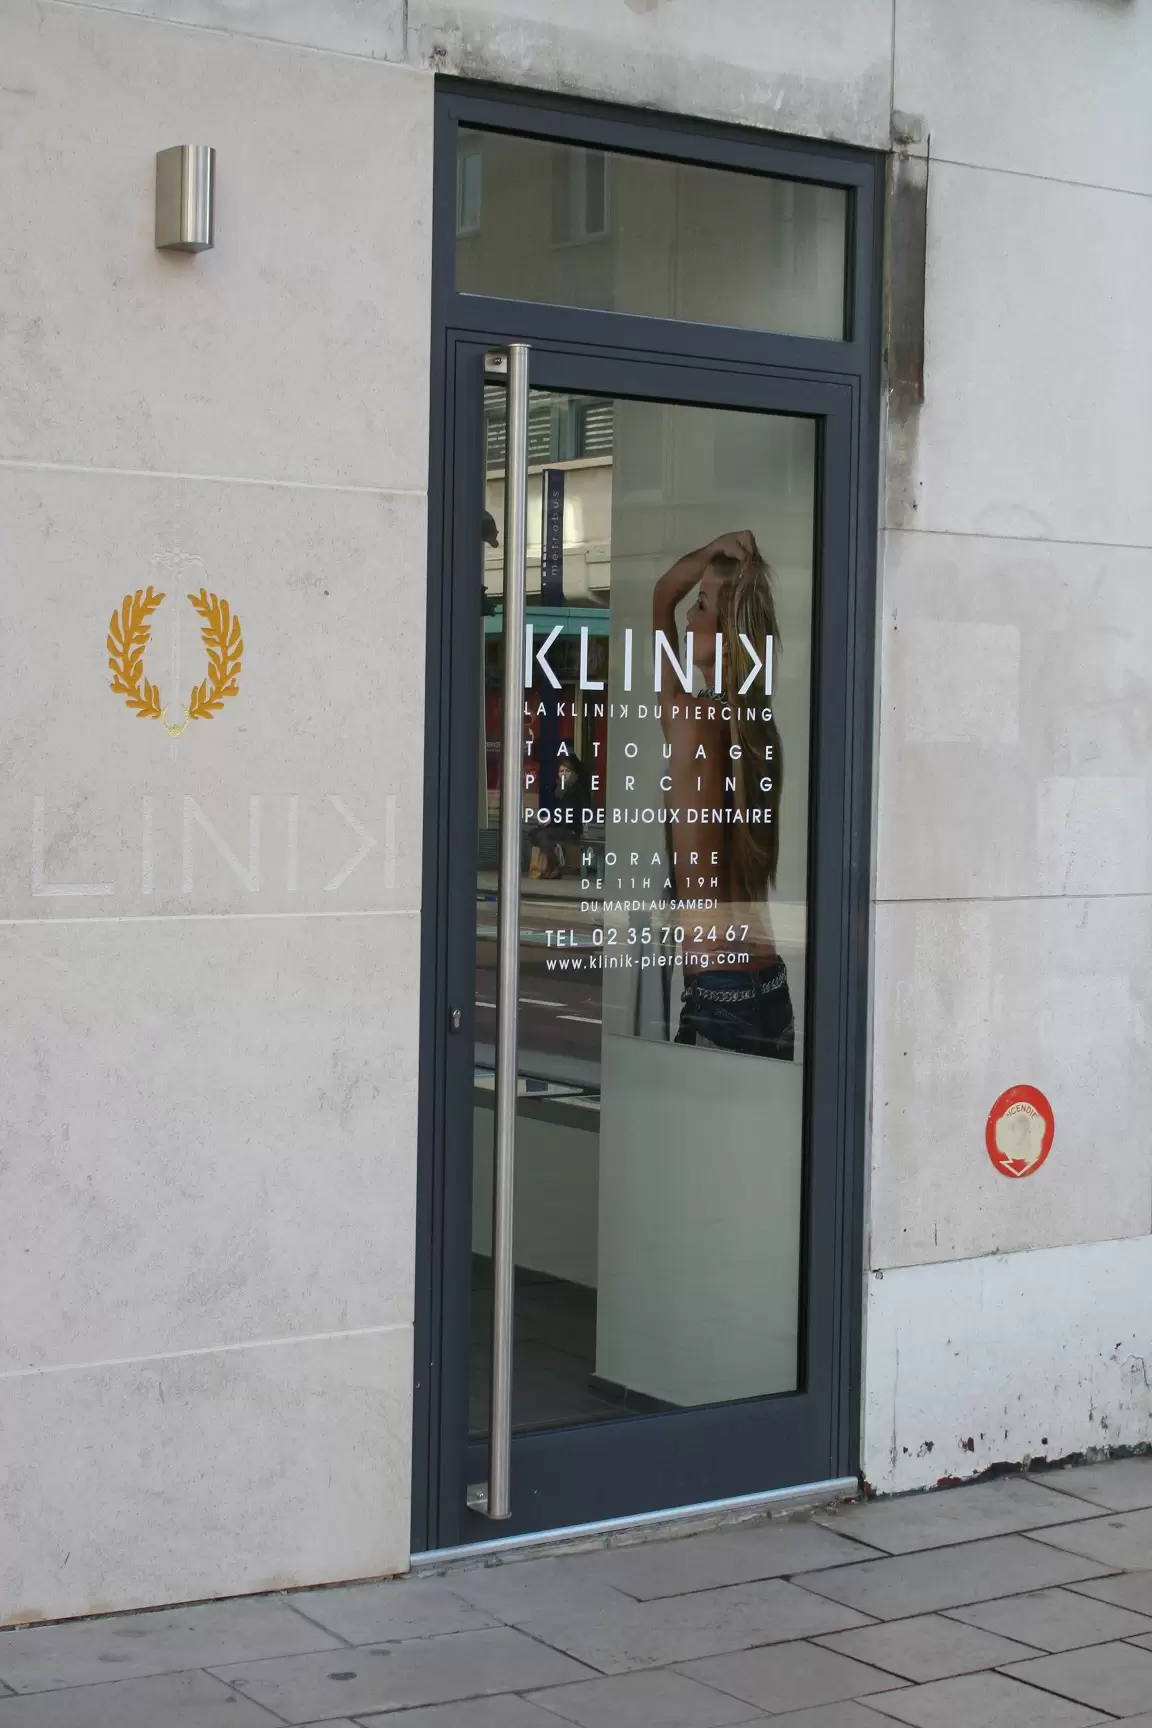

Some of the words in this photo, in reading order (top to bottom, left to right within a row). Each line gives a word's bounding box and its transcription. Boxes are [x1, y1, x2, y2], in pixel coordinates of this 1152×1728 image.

[525, 624, 774, 696] KLINIK
[524, 702, 547, 716] LA
[557, 703, 628, 718] KLINIK
[638, 705, 662, 719] DU
[672, 706, 773, 722] PIERCING
[525, 740, 774, 761] TATOUAGE
[525, 774, 773, 792] PIERCING
[525, 808, 574, 824] POSE
[581, 808, 605, 824] DE
[613, 808, 680, 824] BIJOUX
[687, 808, 772, 824] DENTAIRE
[582, 852, 719, 866] HORAIRE
[581, 878, 604, 890] DE
[617, 877, 651, 889] 11H
[663, 877, 673, 888] A
[685, 876, 719, 888] 19H
[581, 900, 598, 912] DU
[603, 900, 645, 912] MARDI
[649, 898, 666, 911] AU
[670, 898, 718, 910] SAMEDI
[545, 929, 578, 947] TEL
[592, 928, 617, 946] 02
[626, 927, 652, 945] 35
[661, 926, 685, 944] 70
[693, 925, 717, 943] 24
[725, 924, 749, 942] 67
[546, 952, 749, 971] www.klinik-piercing.com
